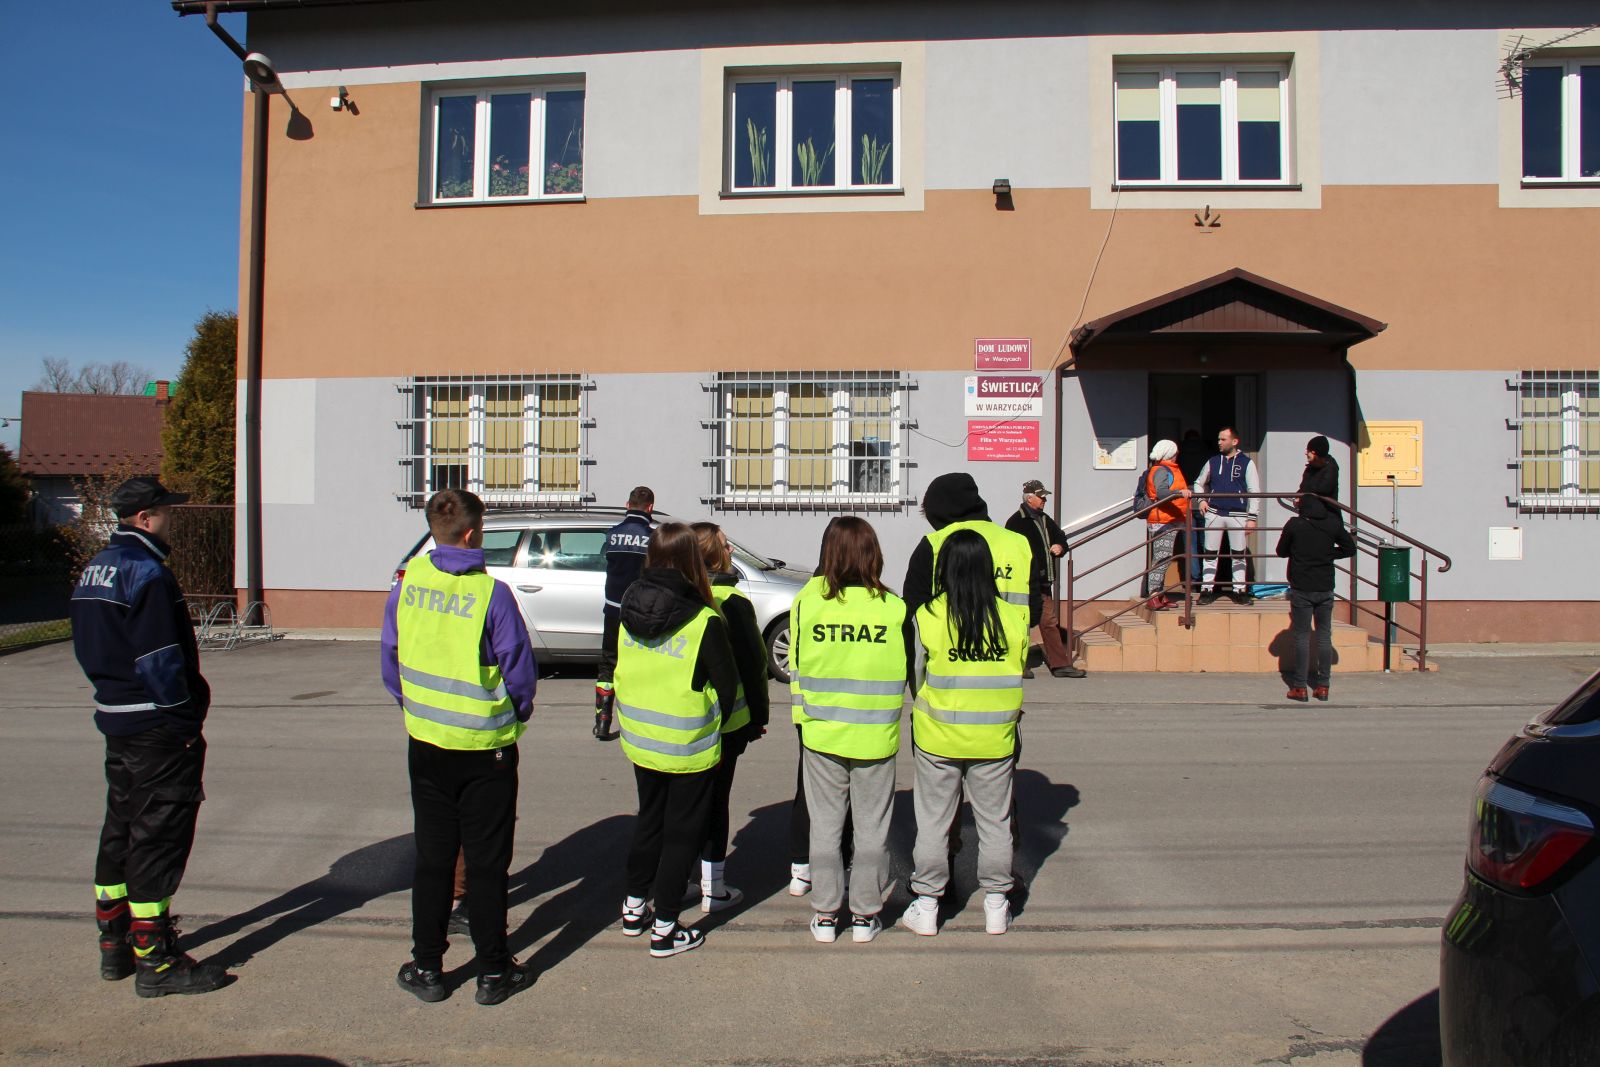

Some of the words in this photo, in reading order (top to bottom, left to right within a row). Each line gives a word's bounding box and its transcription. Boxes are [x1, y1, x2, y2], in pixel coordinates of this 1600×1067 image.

[978, 344, 995, 353] DOM
[998, 344, 1028, 353] LUDOWY
[981, 379, 1039, 393] ŚWIETLICA
[976, 403, 983, 411] W
[986, 403, 1032, 411] WARZYCACH
[405, 584, 477, 619] STRAŻ
